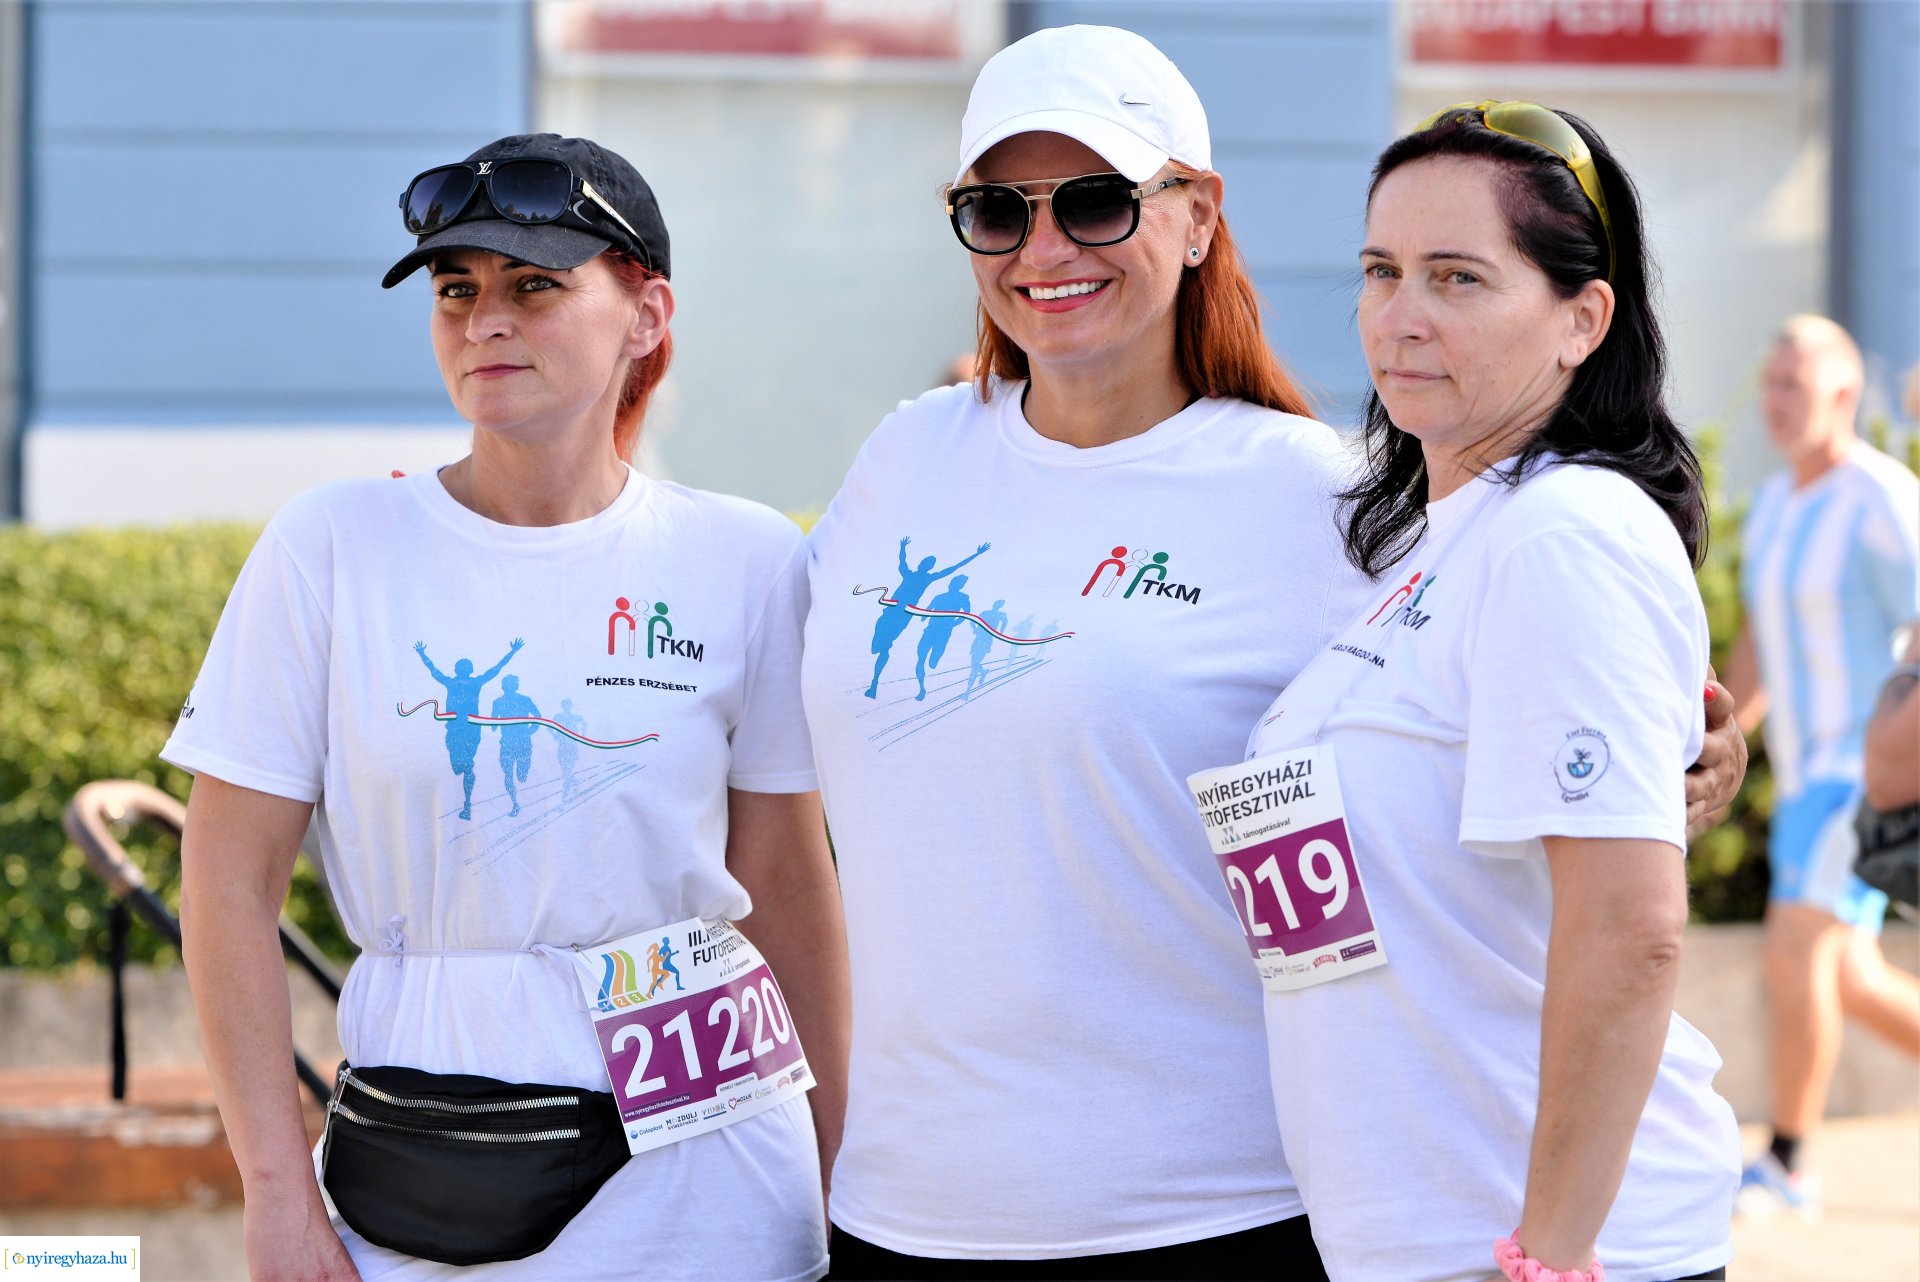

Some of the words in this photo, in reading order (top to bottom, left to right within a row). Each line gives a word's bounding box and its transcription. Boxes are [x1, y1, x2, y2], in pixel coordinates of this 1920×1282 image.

[1143, 579, 1201, 605] TKM
[656, 635, 704, 662] TKM
[586, 676, 635, 687] PÉNZES
[1243, 817, 1291, 839] támogatásával
[617, 998, 626, 1006] 2
[632, 993, 641, 1002] 3
[611, 976, 790, 1099] 21220
